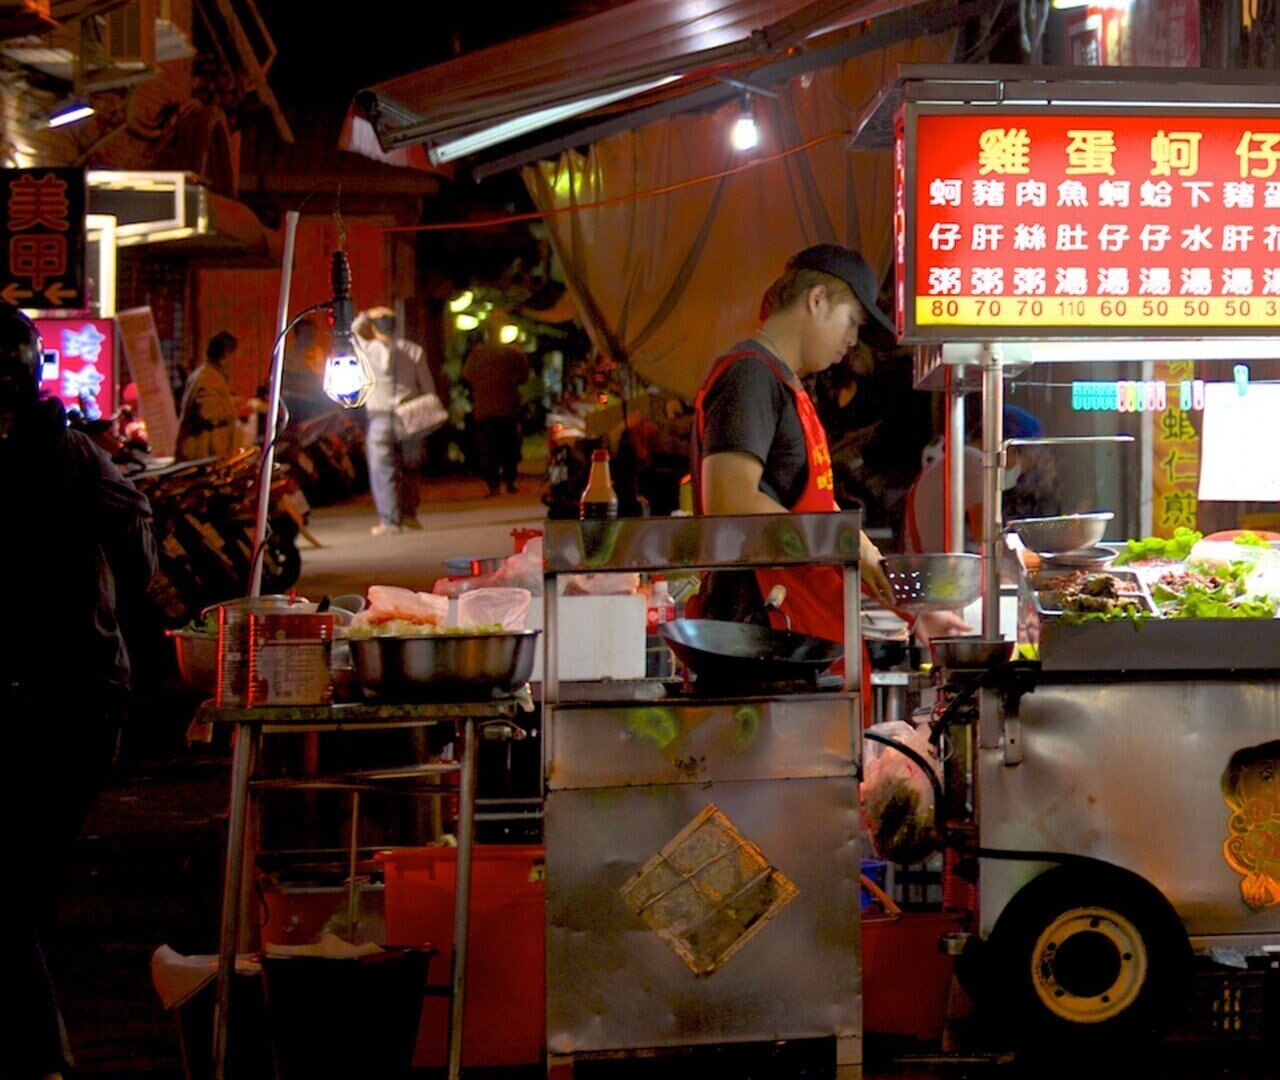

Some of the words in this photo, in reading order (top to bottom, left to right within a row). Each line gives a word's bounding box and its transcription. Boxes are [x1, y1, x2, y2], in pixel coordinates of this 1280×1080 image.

[7, 173, 69, 291] 美甲
[928, 179, 961, 294] 蚵仔粥
[971, 179, 1004, 294] 豬肝粥
[1013, 180, 1046, 294] 肉絲粥
[1055, 180, 1088, 294] 魚肚湯
[1097, 180, 1131, 294] 蚵仔湯
[1138, 180, 1172, 294] 蛤仔湯
[1180, 181, 1213, 294] 下水湯
[1221, 181, 1254, 295] 豬肝湯
[931, 301, 959, 317] 80
[1017, 301, 1043, 317] 70
[1100, 301, 1127, 317] 60
[1183, 301, 1210, 317] 50
